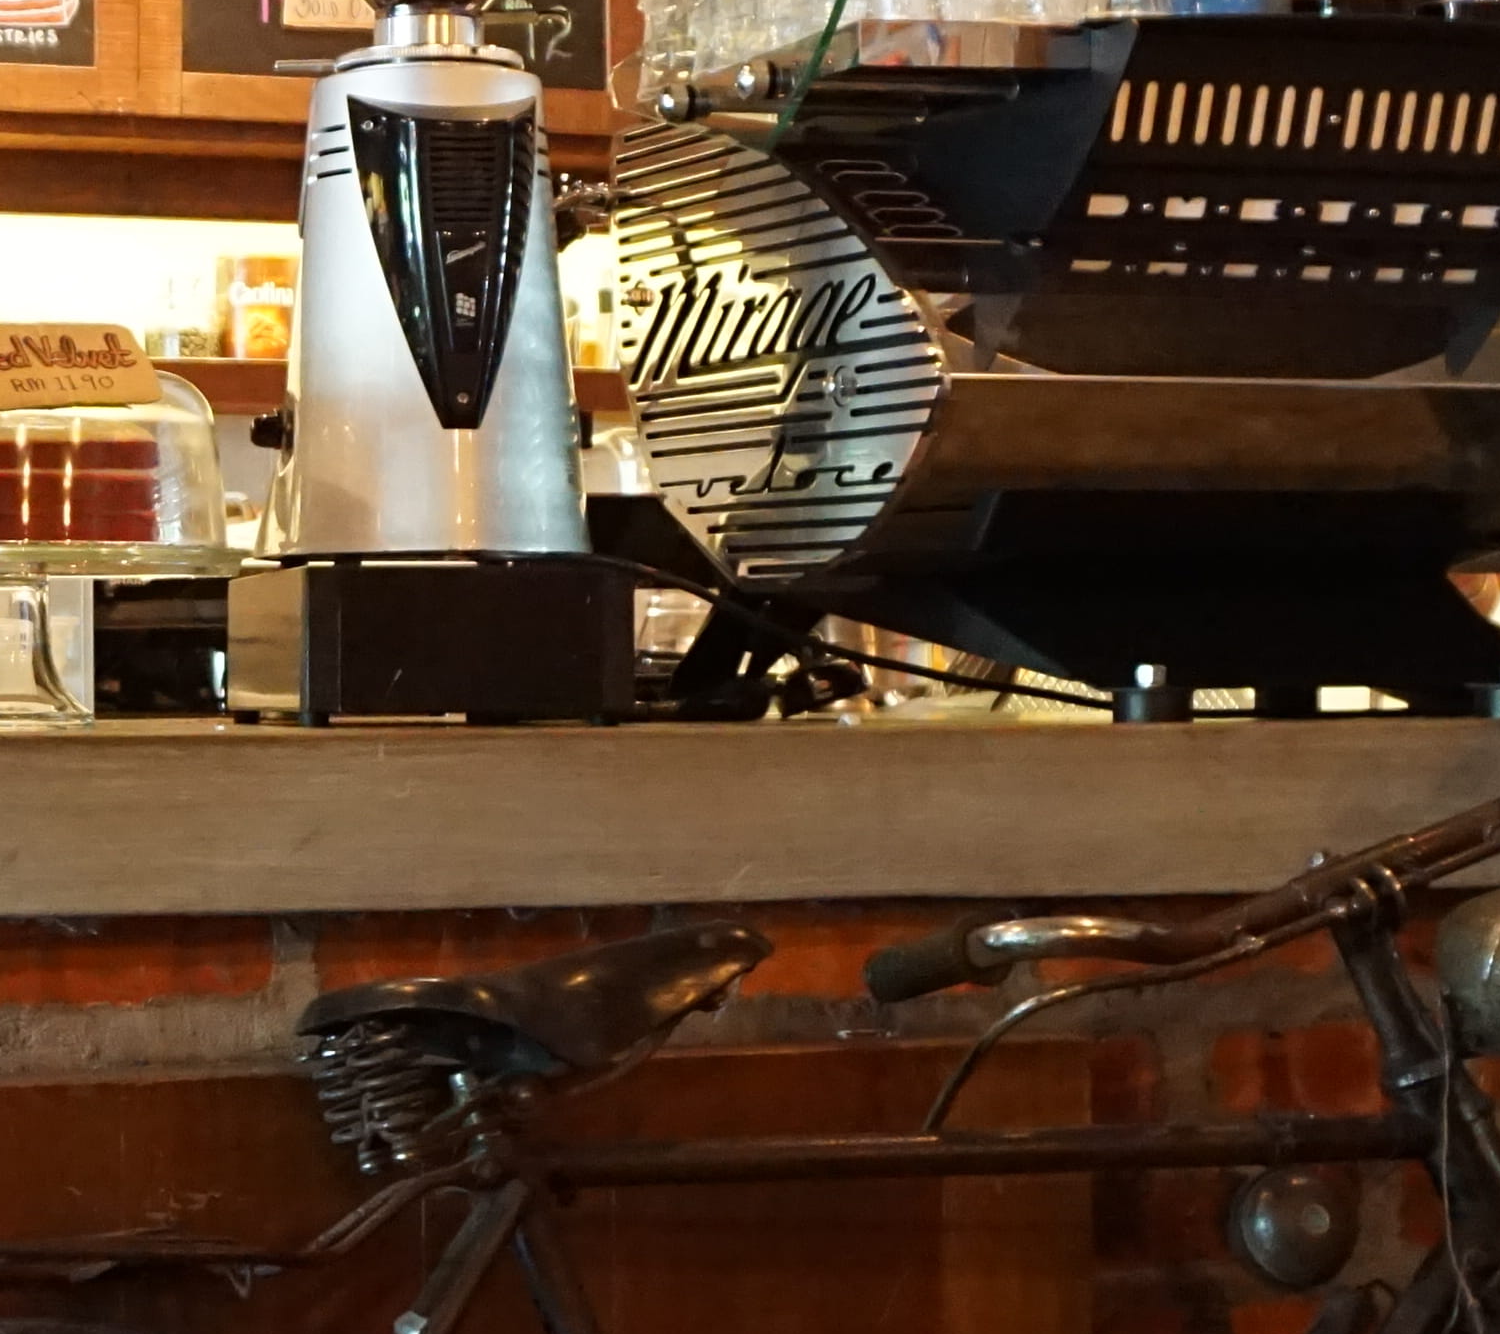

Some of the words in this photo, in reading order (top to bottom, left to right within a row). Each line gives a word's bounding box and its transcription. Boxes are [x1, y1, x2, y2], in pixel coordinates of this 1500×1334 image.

[22, 330, 140, 373] Velvet
[630, 264, 877, 385] Mirage
[9, 375, 47, 394] RM
[660, 433, 906, 499] veloce
